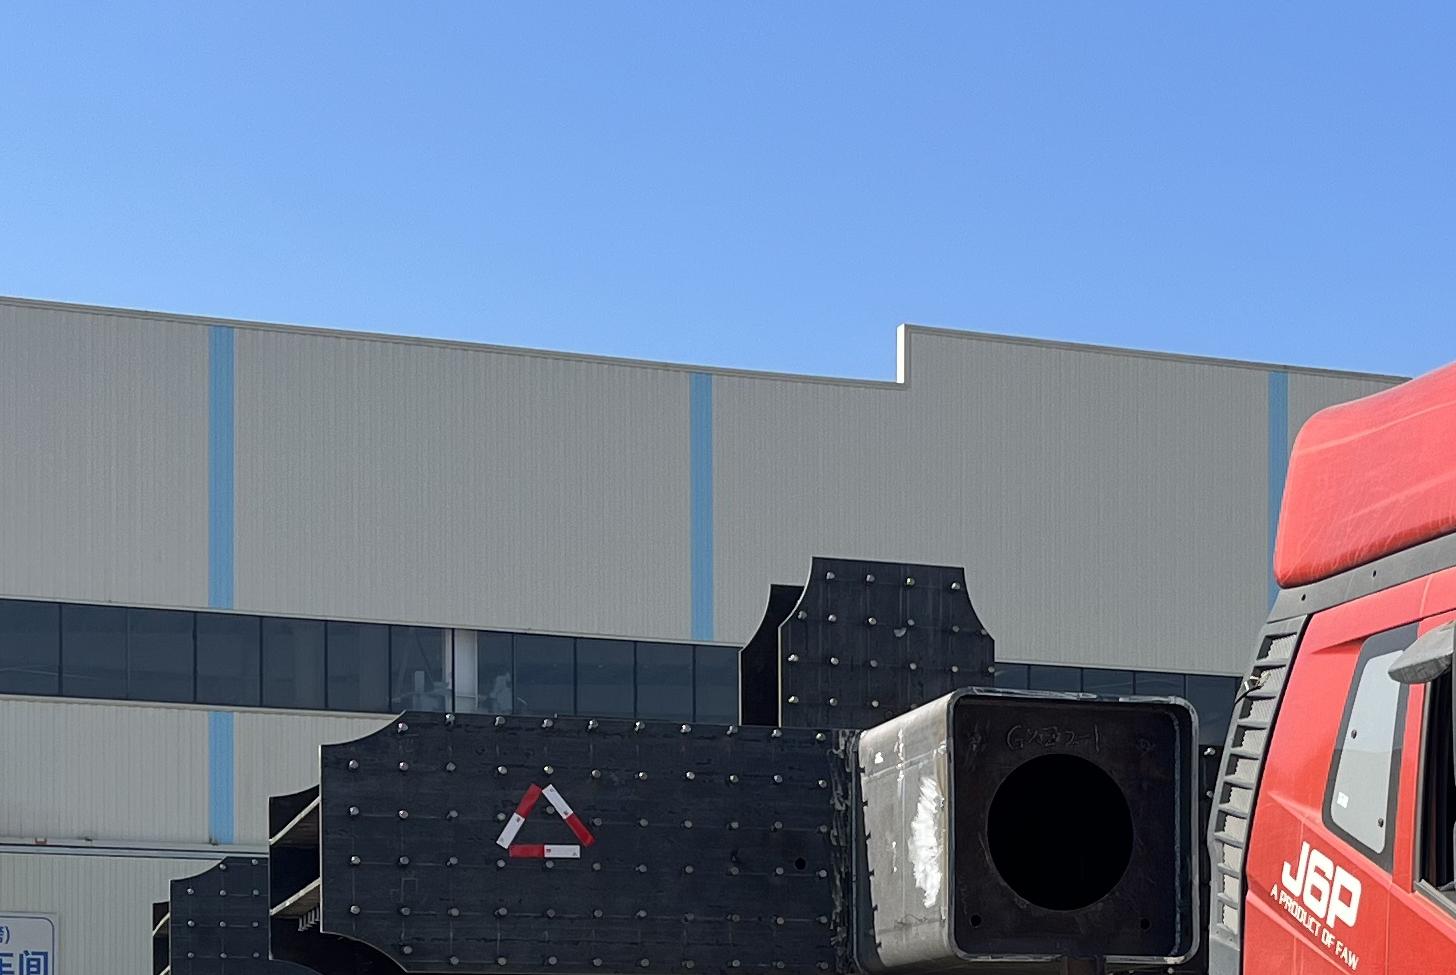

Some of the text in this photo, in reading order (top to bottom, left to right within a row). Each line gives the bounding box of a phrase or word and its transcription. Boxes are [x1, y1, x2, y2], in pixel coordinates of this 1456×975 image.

[1270, 883, 1360, 971] A PRODUCT OF FAW
[1281, 841, 1362, 928] J6P
